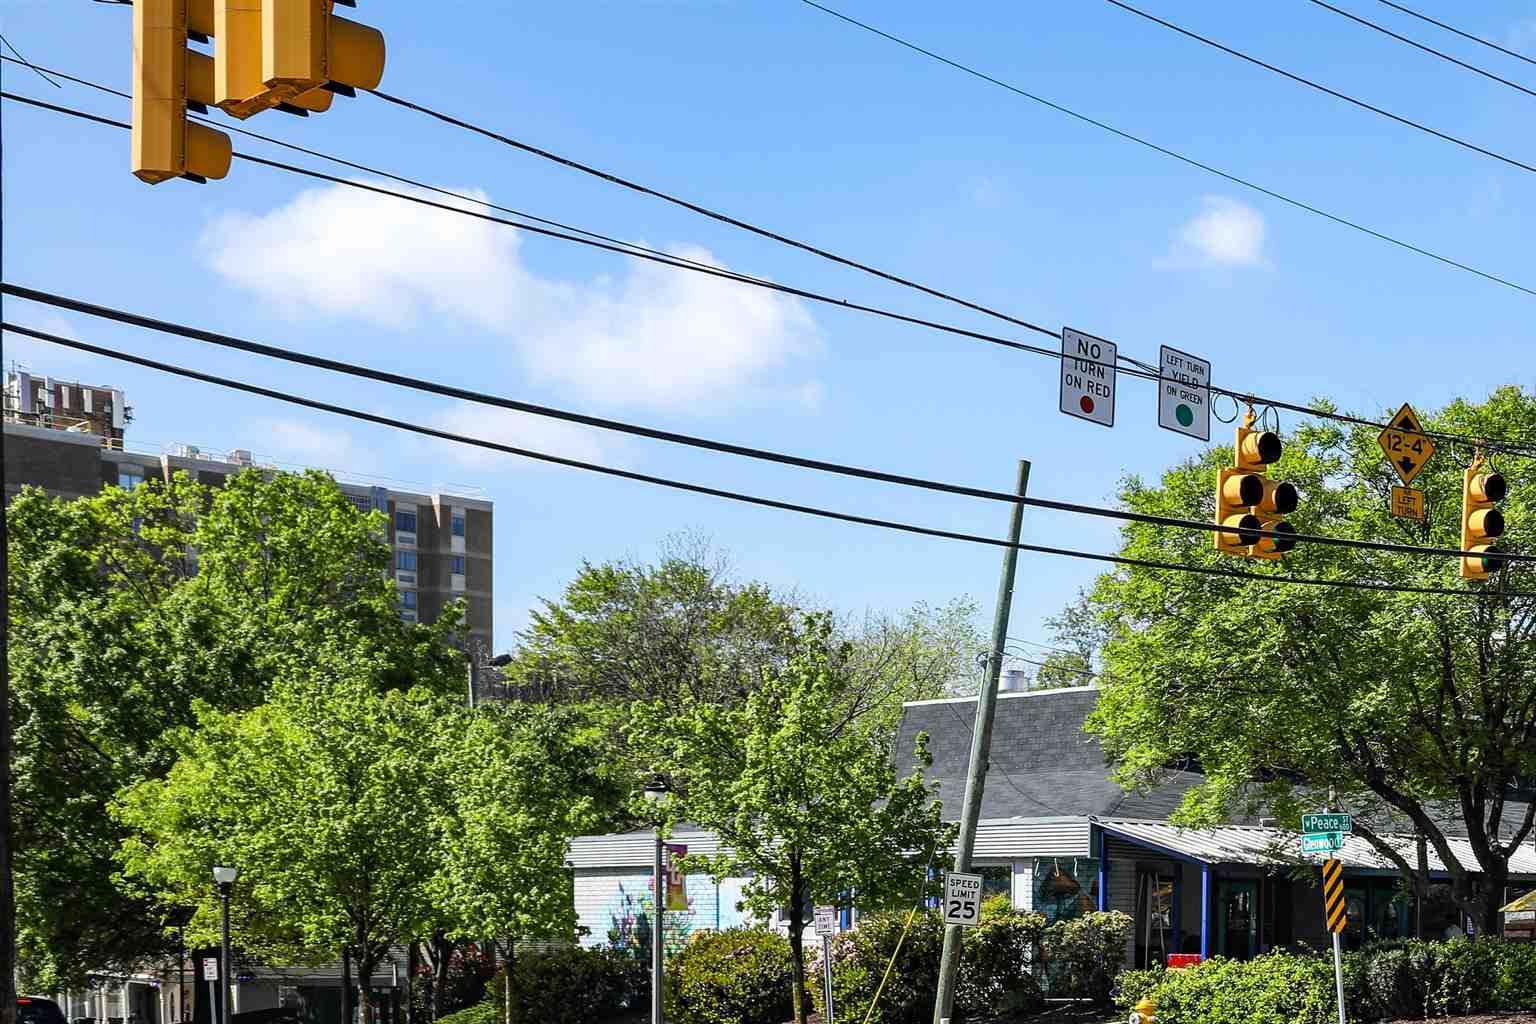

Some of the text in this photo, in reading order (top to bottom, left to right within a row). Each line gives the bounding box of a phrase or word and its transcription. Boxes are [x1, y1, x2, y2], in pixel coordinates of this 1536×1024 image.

[1078, 339, 1101, 360] NO
[1073, 359, 1105, 379] TURN
[1166, 354, 1205, 376] LEFT TURN
[1065, 374, 1111, 398] ON RED
[1172, 370, 1199, 389] YIELD
[1167, 385, 1203, 405] ON GREEN
[1398, 505, 1418, 517] TURN
[1311, 816, 1339, 830] Peace
[950, 879, 979, 889] SPEED
[952, 889, 977, 898] LIMIT
[948, 900, 976, 919] 25
